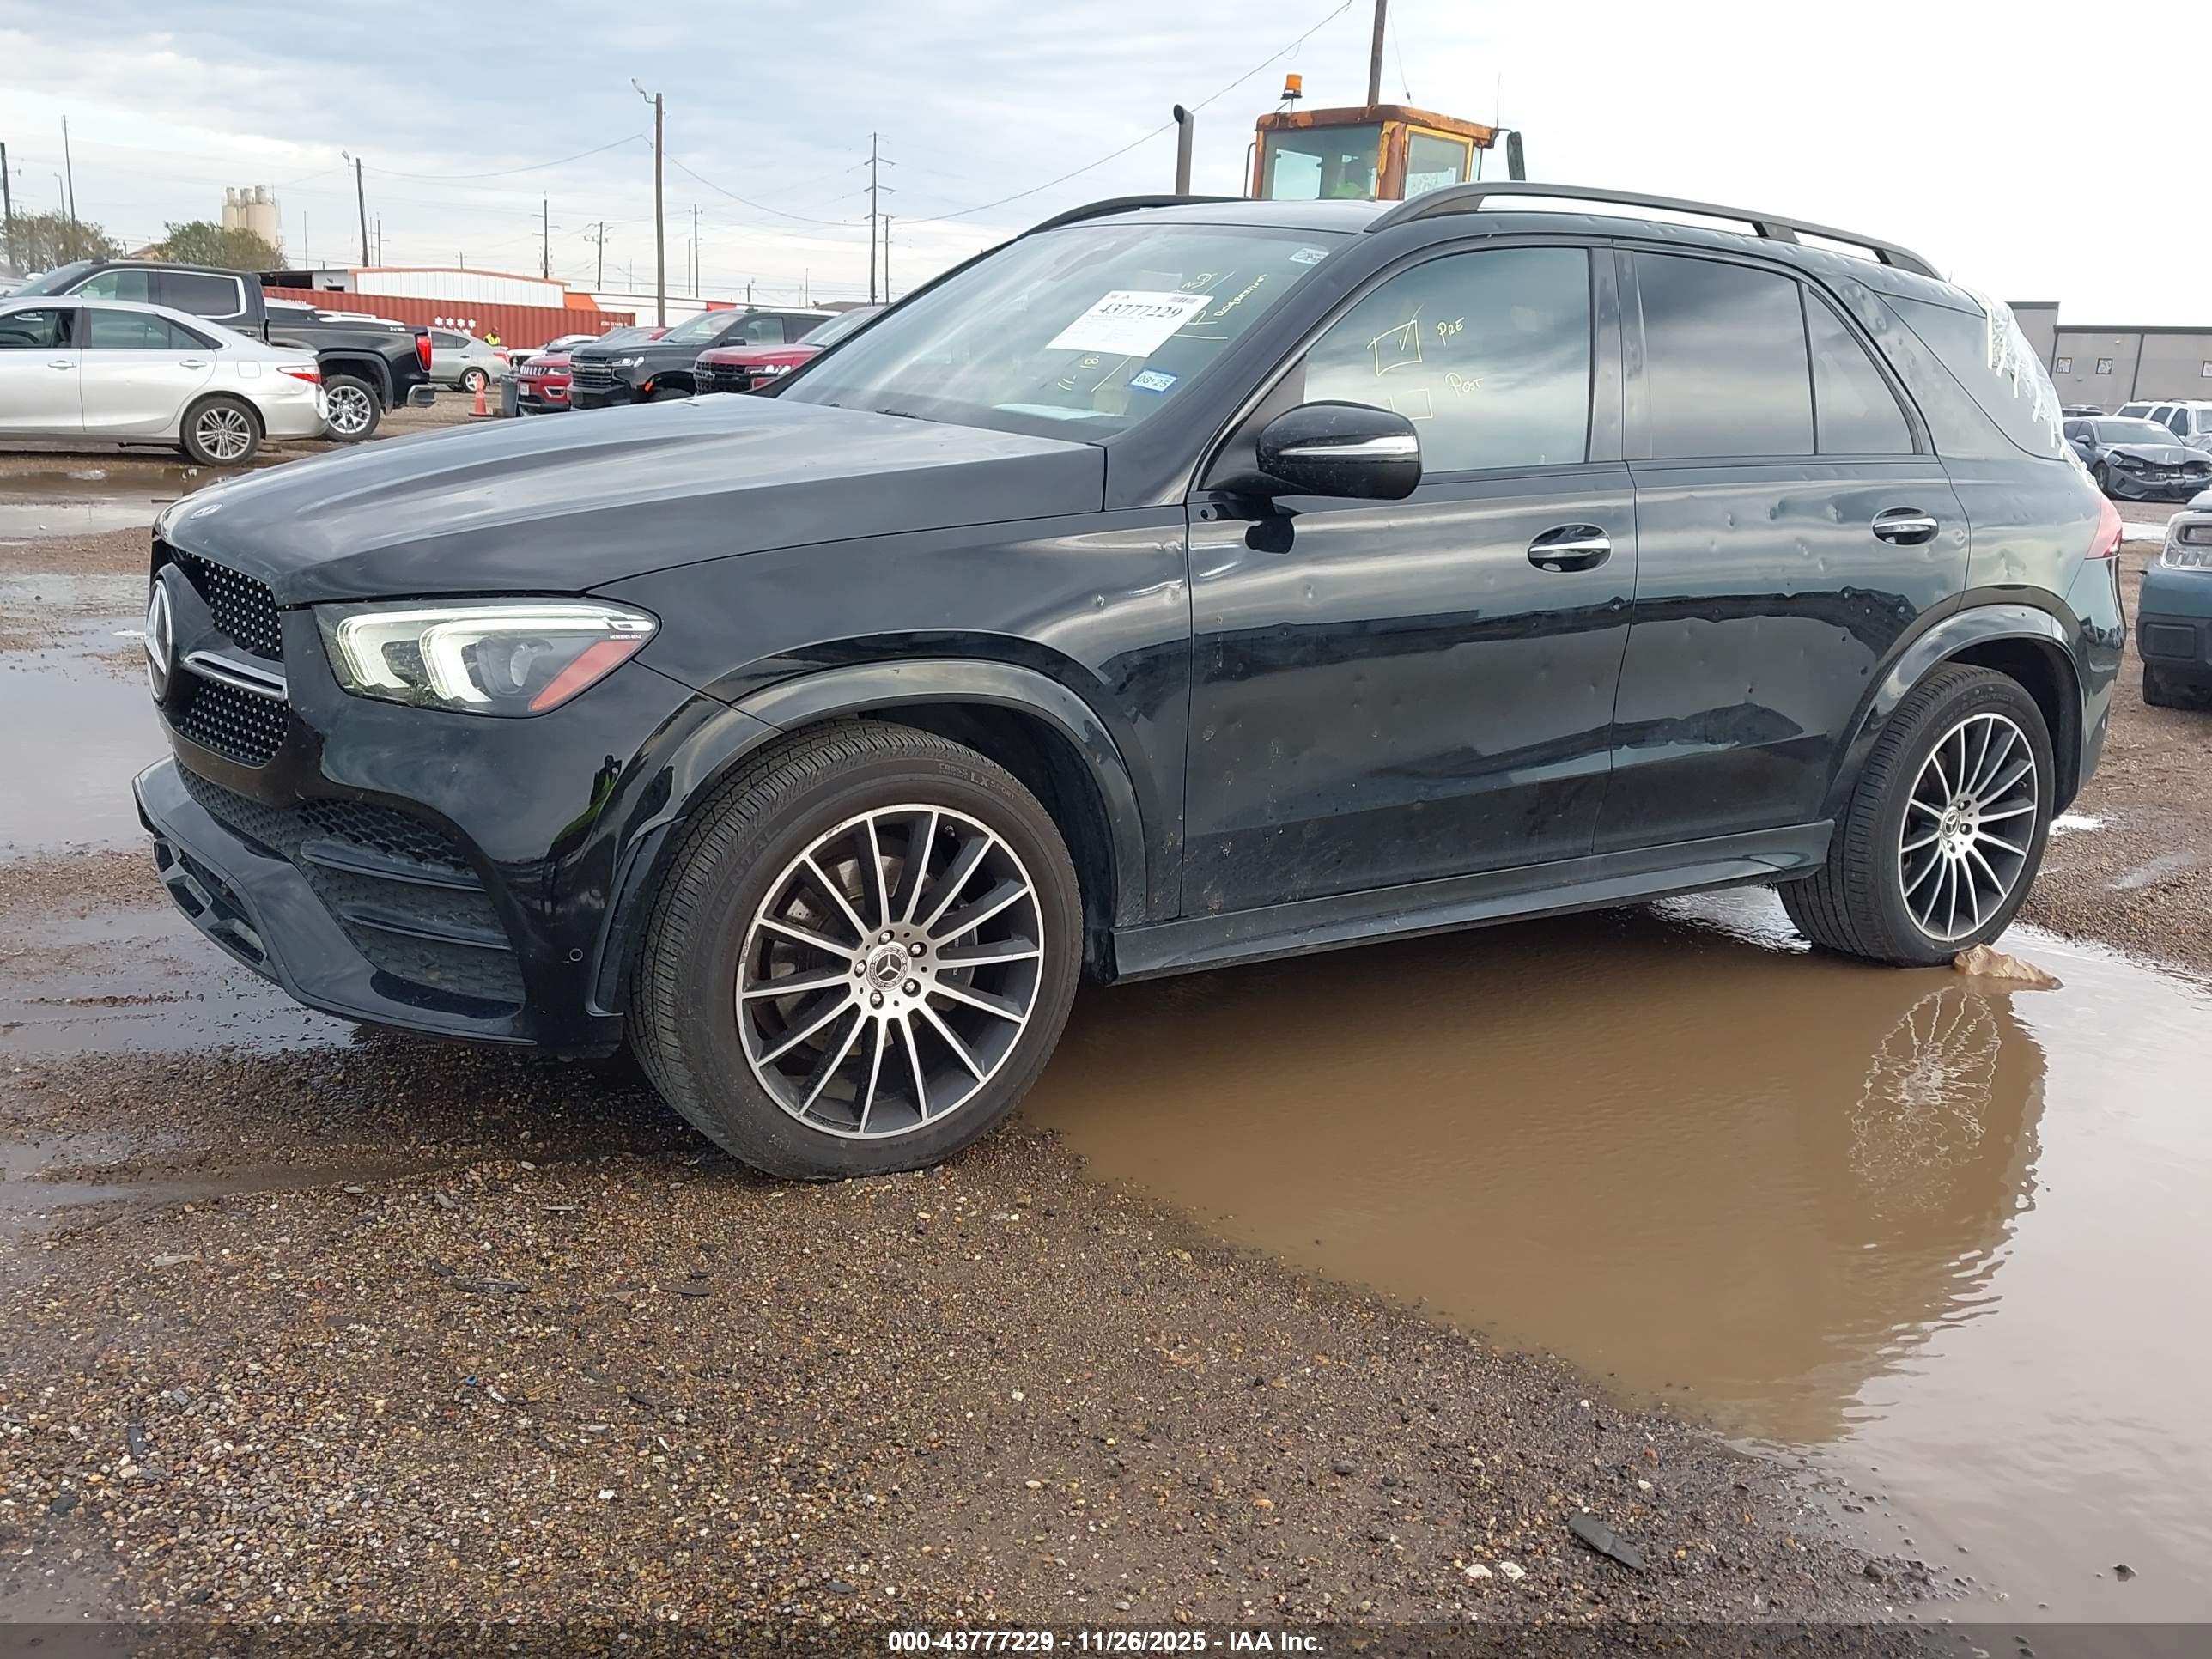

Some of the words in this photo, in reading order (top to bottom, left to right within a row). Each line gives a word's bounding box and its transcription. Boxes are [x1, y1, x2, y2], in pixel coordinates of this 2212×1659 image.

[1098, 302, 1184, 319] 43777229
[1437, 317, 1465, 347] PRE
[969, 771, 991, 788] LX
